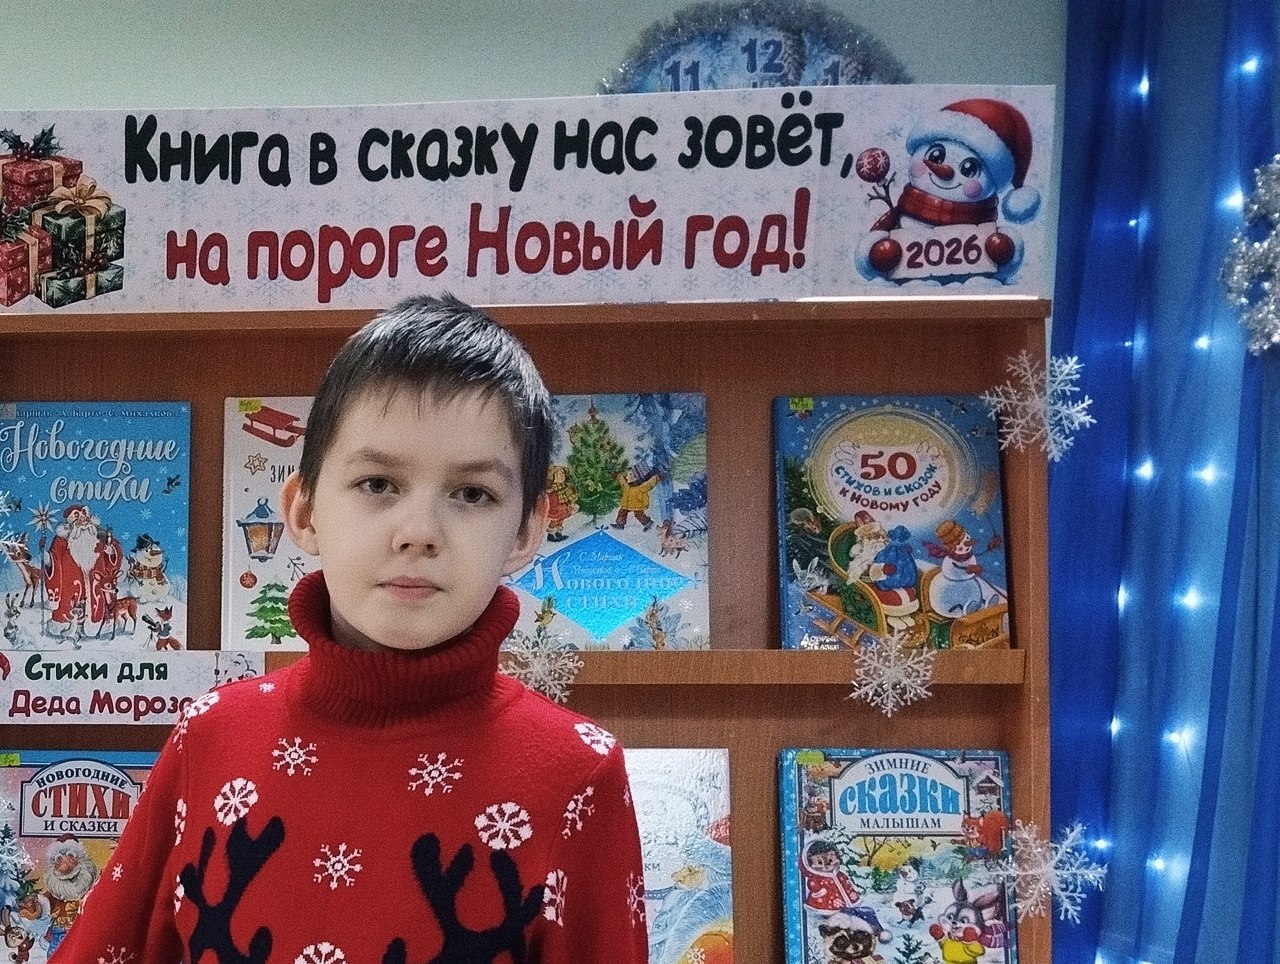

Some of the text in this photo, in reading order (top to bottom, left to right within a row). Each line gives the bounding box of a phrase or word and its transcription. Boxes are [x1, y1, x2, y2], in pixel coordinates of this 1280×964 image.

[741, 38, 784, 74] 12
[665, 60, 700, 91] 11
[124, 91, 854, 192] Книга в сказку нас зовёт,
[166, 187, 812, 304] на пороге Новый год!
[905, 234, 983, 269] 2026
[860, 451, 917, 480] 50
[25, 654, 168, 683] Стихи для
[9, 690, 81, 717] Деда
[35, 767, 128, 790] НОВОГОДНИЕ
[865, 758, 931, 774] ЗИМНИЕ
[31, 783, 132, 819] СТИХИ
[43, 820, 119, 832] И СКАЗКИ
[860, 817, 941, 829] МАЛЫШАМ
